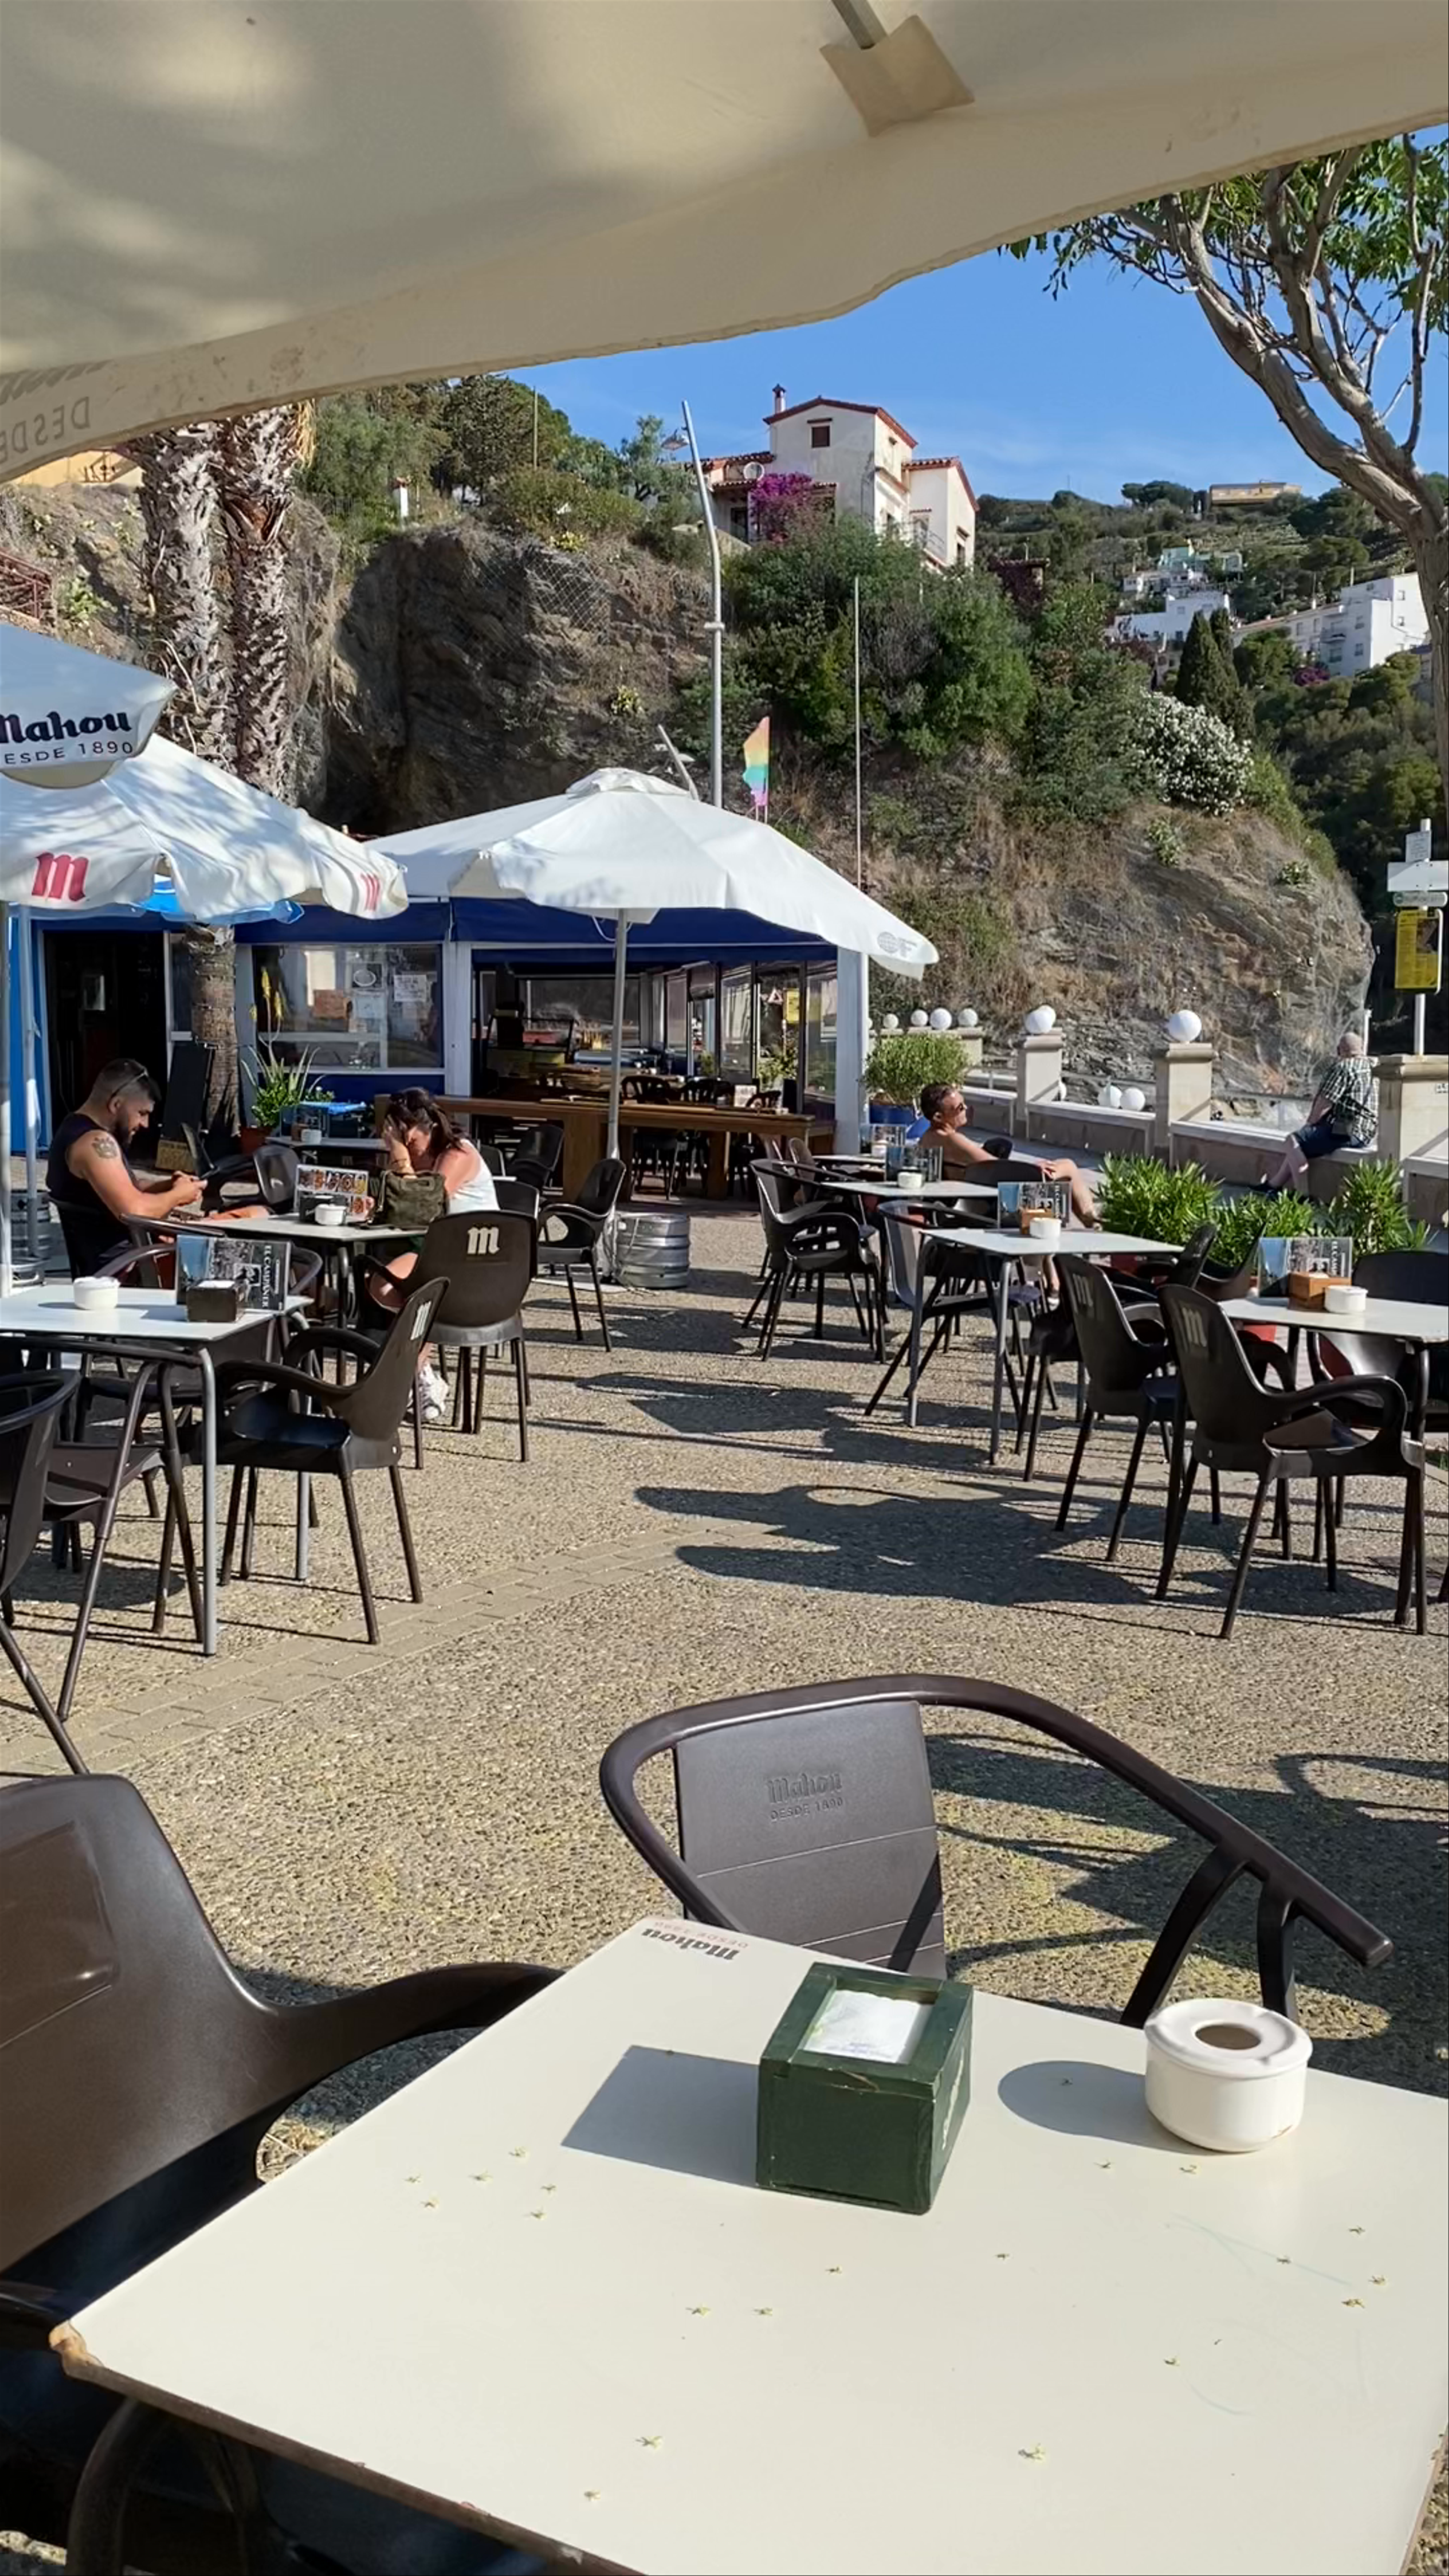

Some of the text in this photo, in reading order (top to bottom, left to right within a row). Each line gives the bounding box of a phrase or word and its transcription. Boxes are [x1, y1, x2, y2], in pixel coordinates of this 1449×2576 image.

[0, 711, 132, 743] Mahou
[5, 741, 132, 764] ESDE 1890
[767, 1773, 842, 1803] Mahou
[771, 1804, 810, 1820] DESDE
[641, 1929, 739, 1960] Mahou
